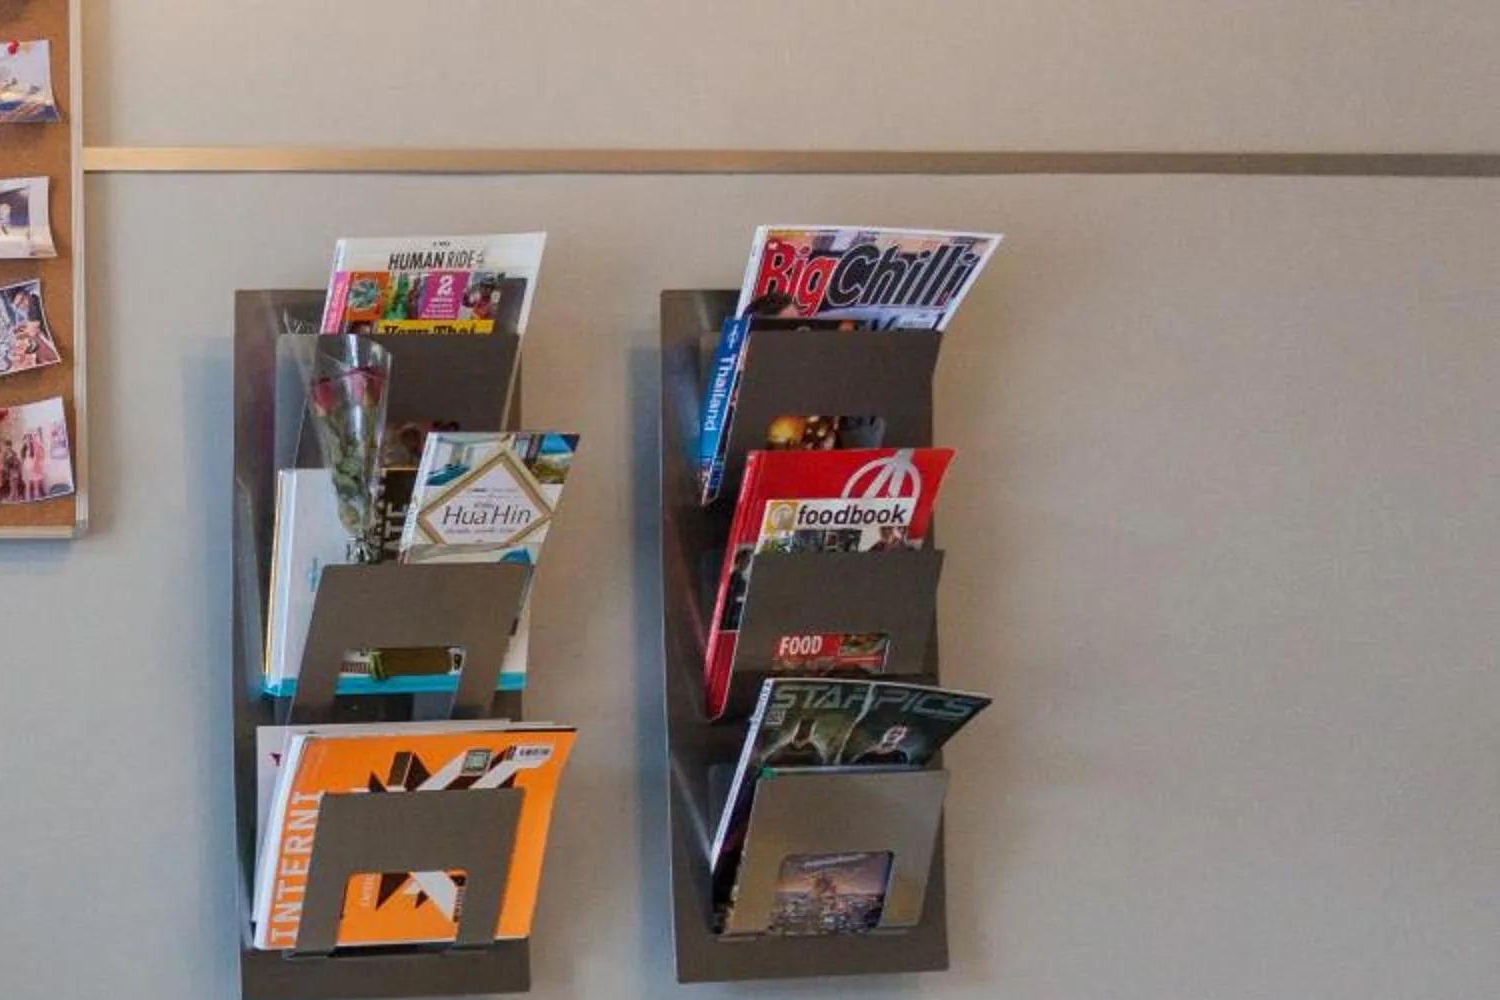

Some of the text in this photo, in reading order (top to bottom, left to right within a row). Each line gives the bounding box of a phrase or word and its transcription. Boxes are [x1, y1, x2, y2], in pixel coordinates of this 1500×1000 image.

[387, 250, 444, 271] HUMAN
[435, 275, 456, 296] 2
[703, 353, 736, 432] Thailand
[442, 504, 488, 526] Hua
[490, 502, 532, 525] Hin
[797, 503, 908, 526] foodbook
[779, 634, 823, 657] FOOD
